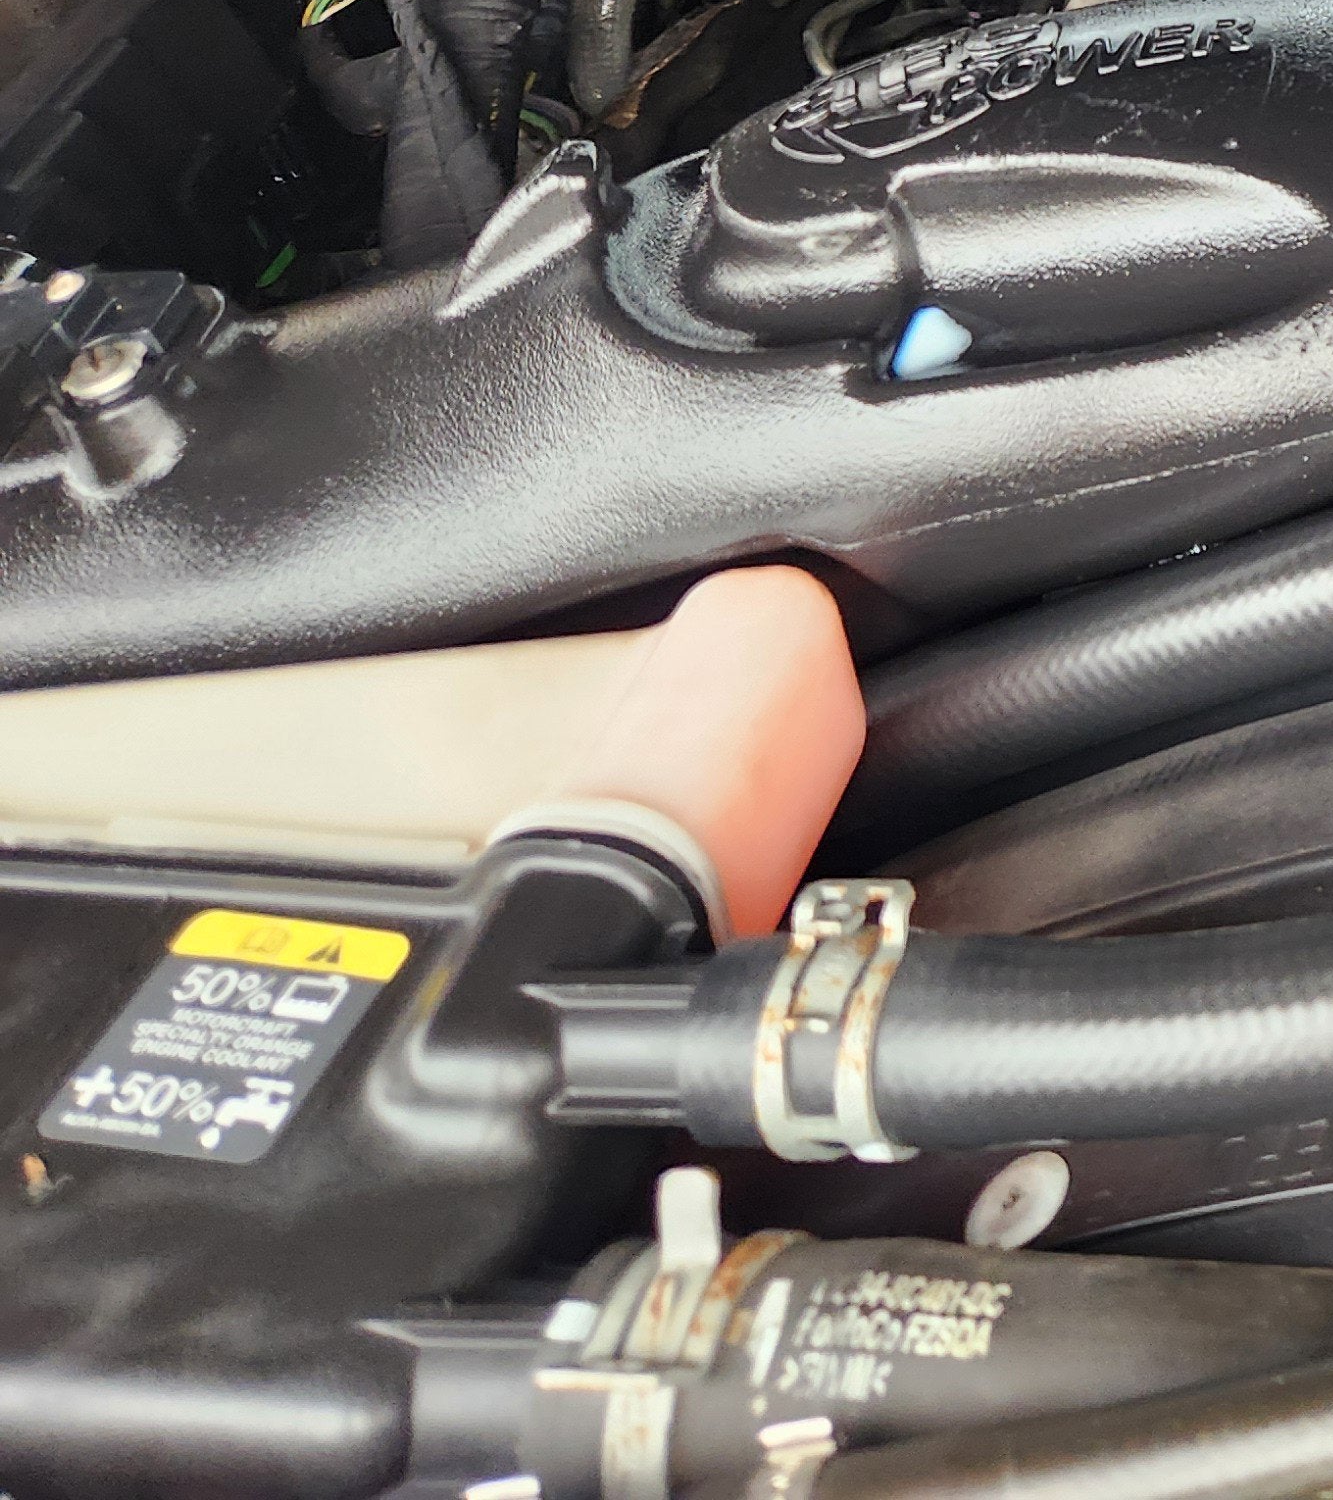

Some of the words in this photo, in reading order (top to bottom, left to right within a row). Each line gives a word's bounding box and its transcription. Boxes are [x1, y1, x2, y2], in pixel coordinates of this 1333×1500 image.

[172, 964, 276, 1012] 50%
[133, 1020, 234, 1046] SPECIALTY
[233, 1034, 315, 1058] ORANGE
[172, 1008, 298, 1037] MOTORCRAFT
[130, 1037, 199, 1063] ENGINE
[202, 1047, 292, 1074] COOLANT
